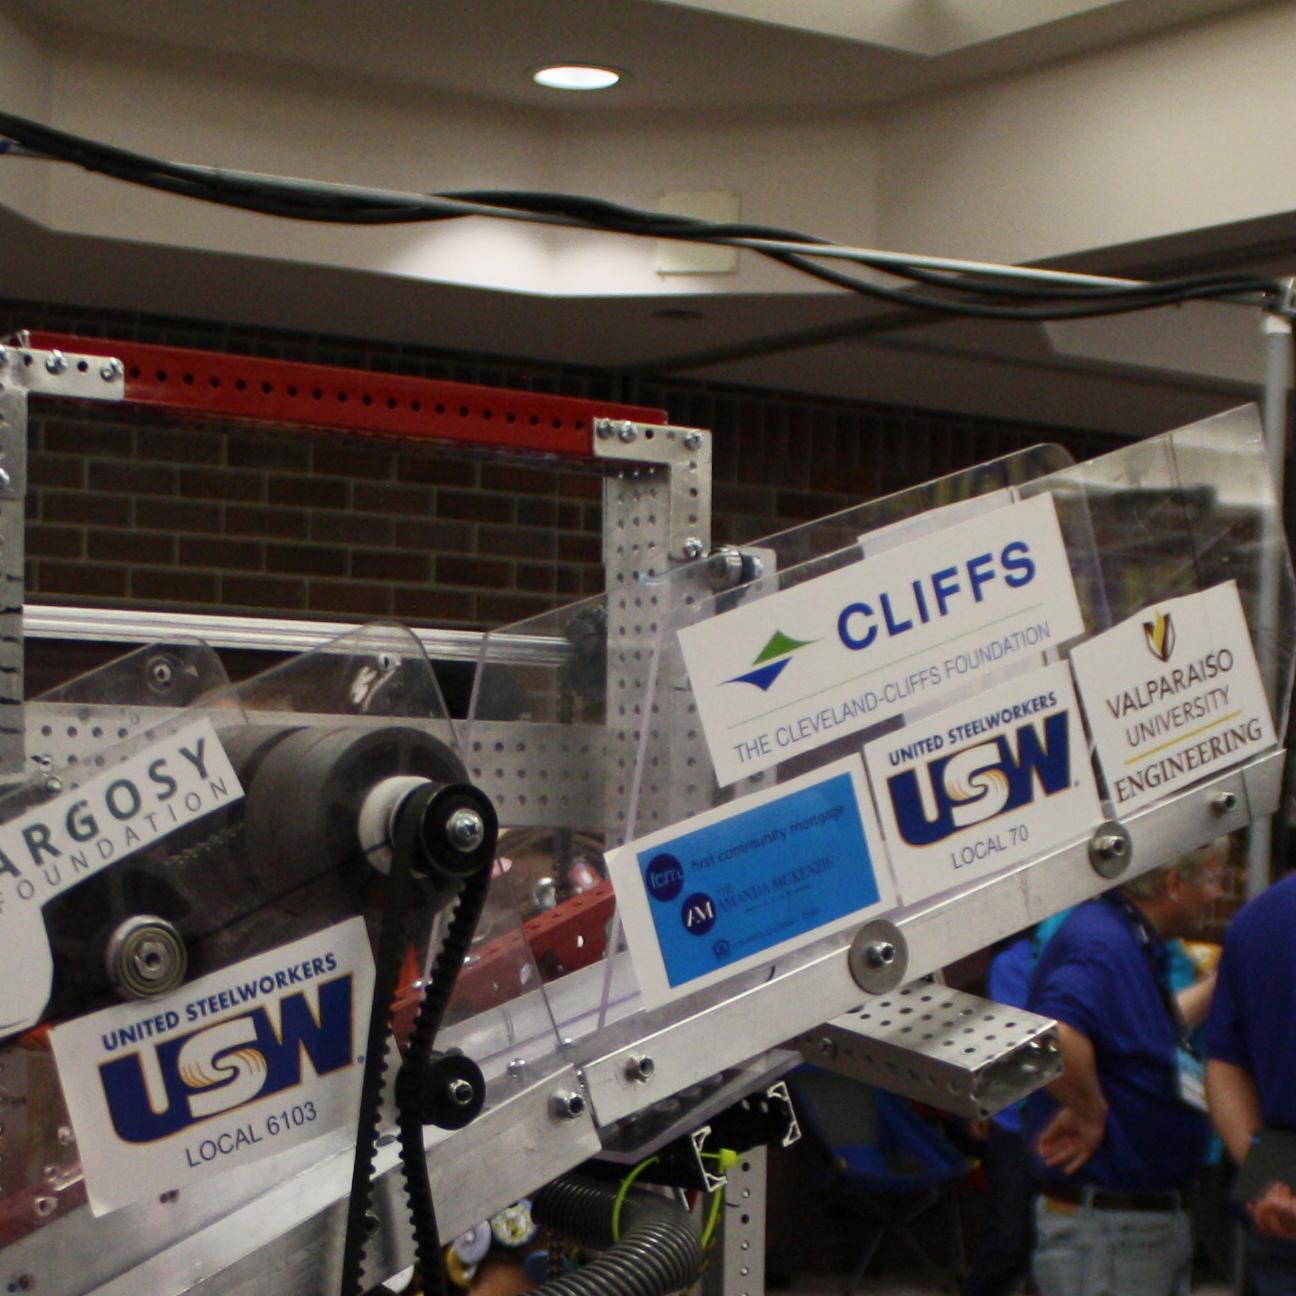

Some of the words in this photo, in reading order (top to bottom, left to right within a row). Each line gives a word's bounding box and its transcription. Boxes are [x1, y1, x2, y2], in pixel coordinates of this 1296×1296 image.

[836, 541, 1036, 651] CLIFFS
[733, 732, 772, 764] THE
[776, 664, 943, 747] CLEVELAND-CLIFFS
[944, 620, 1051, 679] FOUNDATION
[1106, 649, 1234, 720] VALPARAISO
[1125, 684, 1231, 747] UNIVERSITY
[887, 733, 945, 767] UNITED
[947, 691, 1058, 746] STEELWORKERS
[1113, 718, 1263, 803] ENGINEERING
[886, 708, 1071, 849] USW
[718, 828, 787, 863] community
[789, 804, 846, 835] mortgage
[950, 829, 1008, 871] LOCAL
[1008, 823, 1030, 848] 70
[101, 1010, 180, 1052] UNITED
[185, 952, 338, 1023] STEELWORKERS
[97, 970, 354, 1146] USW
[184, 1123, 264, 1168] LOCAL
[266, 1100, 318, 1136] 6103
